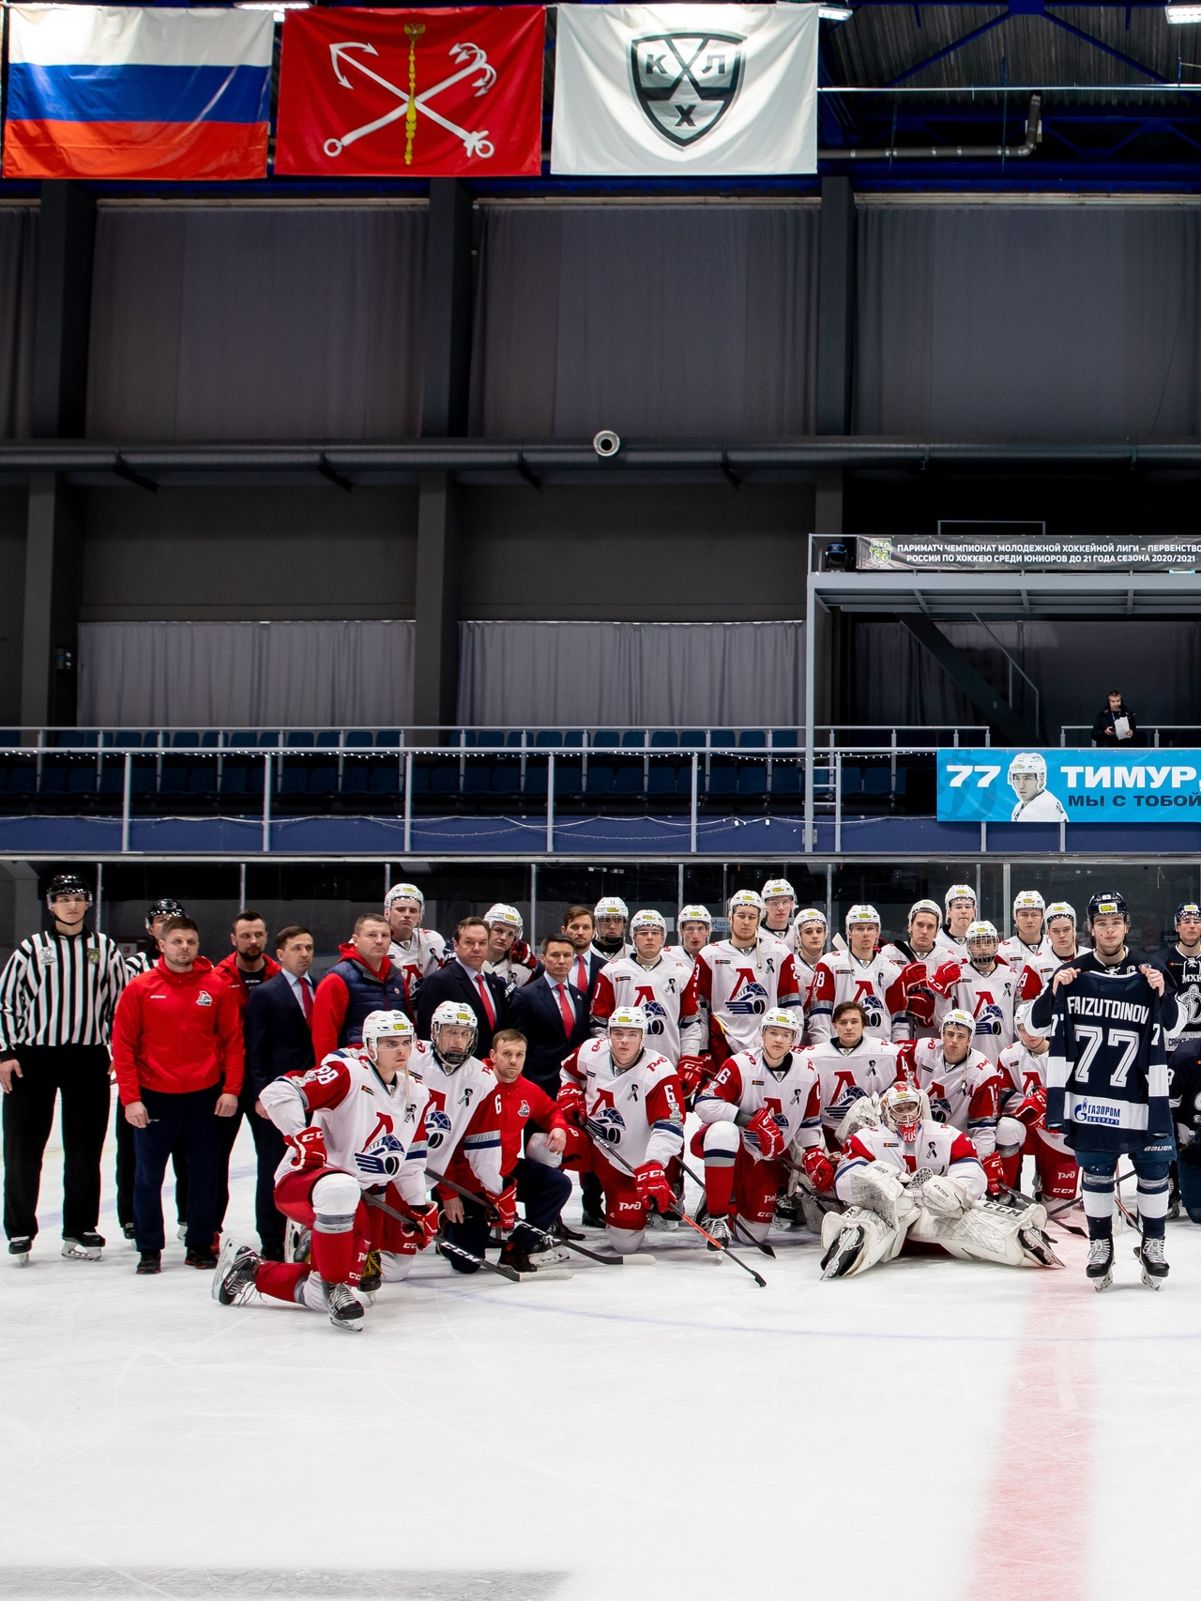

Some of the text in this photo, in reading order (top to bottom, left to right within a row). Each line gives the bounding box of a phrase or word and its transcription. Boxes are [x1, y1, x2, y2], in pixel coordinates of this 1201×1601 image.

[897, 544, 943, 553] ПАРИМАТЧ
[945, 544, 997, 553] ЧЕМПИОНАТ
[998, 543, 1061, 553] МОЛОДЕЖНОЙ
[1062, 543, 1115, 553] ХОККЕЙНОЙ
[1116, 543, 1139, 553] ЛИГИ
[907, 554, 1196, 564] РОССИИ ПО ХОККЕЮ СРЕДИ ЮНИОРОВ ДО 21 ГОДА СЕЗОНА 2020/2021
[946, 765, 1001, 788] 77
[1068, 795, 1104, 807] МЫ
[1112, 795, 1126, 807] С
[1067, 996, 1150, 1025] FAIZUTDINOV
[1073, 1024, 1140, 1088] 77
[664, 1084, 675, 1104] 6
[494, 1093, 502, 1115] 6
[1087, 1104, 1121, 1118] ГАЗПРОМ
[1087, 1116, 1120, 1126] ЭКСПОРТ
[302, 1130, 323, 1142] CC
[983, 1202, 1023, 1217] CCM
[440, 1241, 480, 1262] CCM
[347, 1271, 361, 1281] CC
